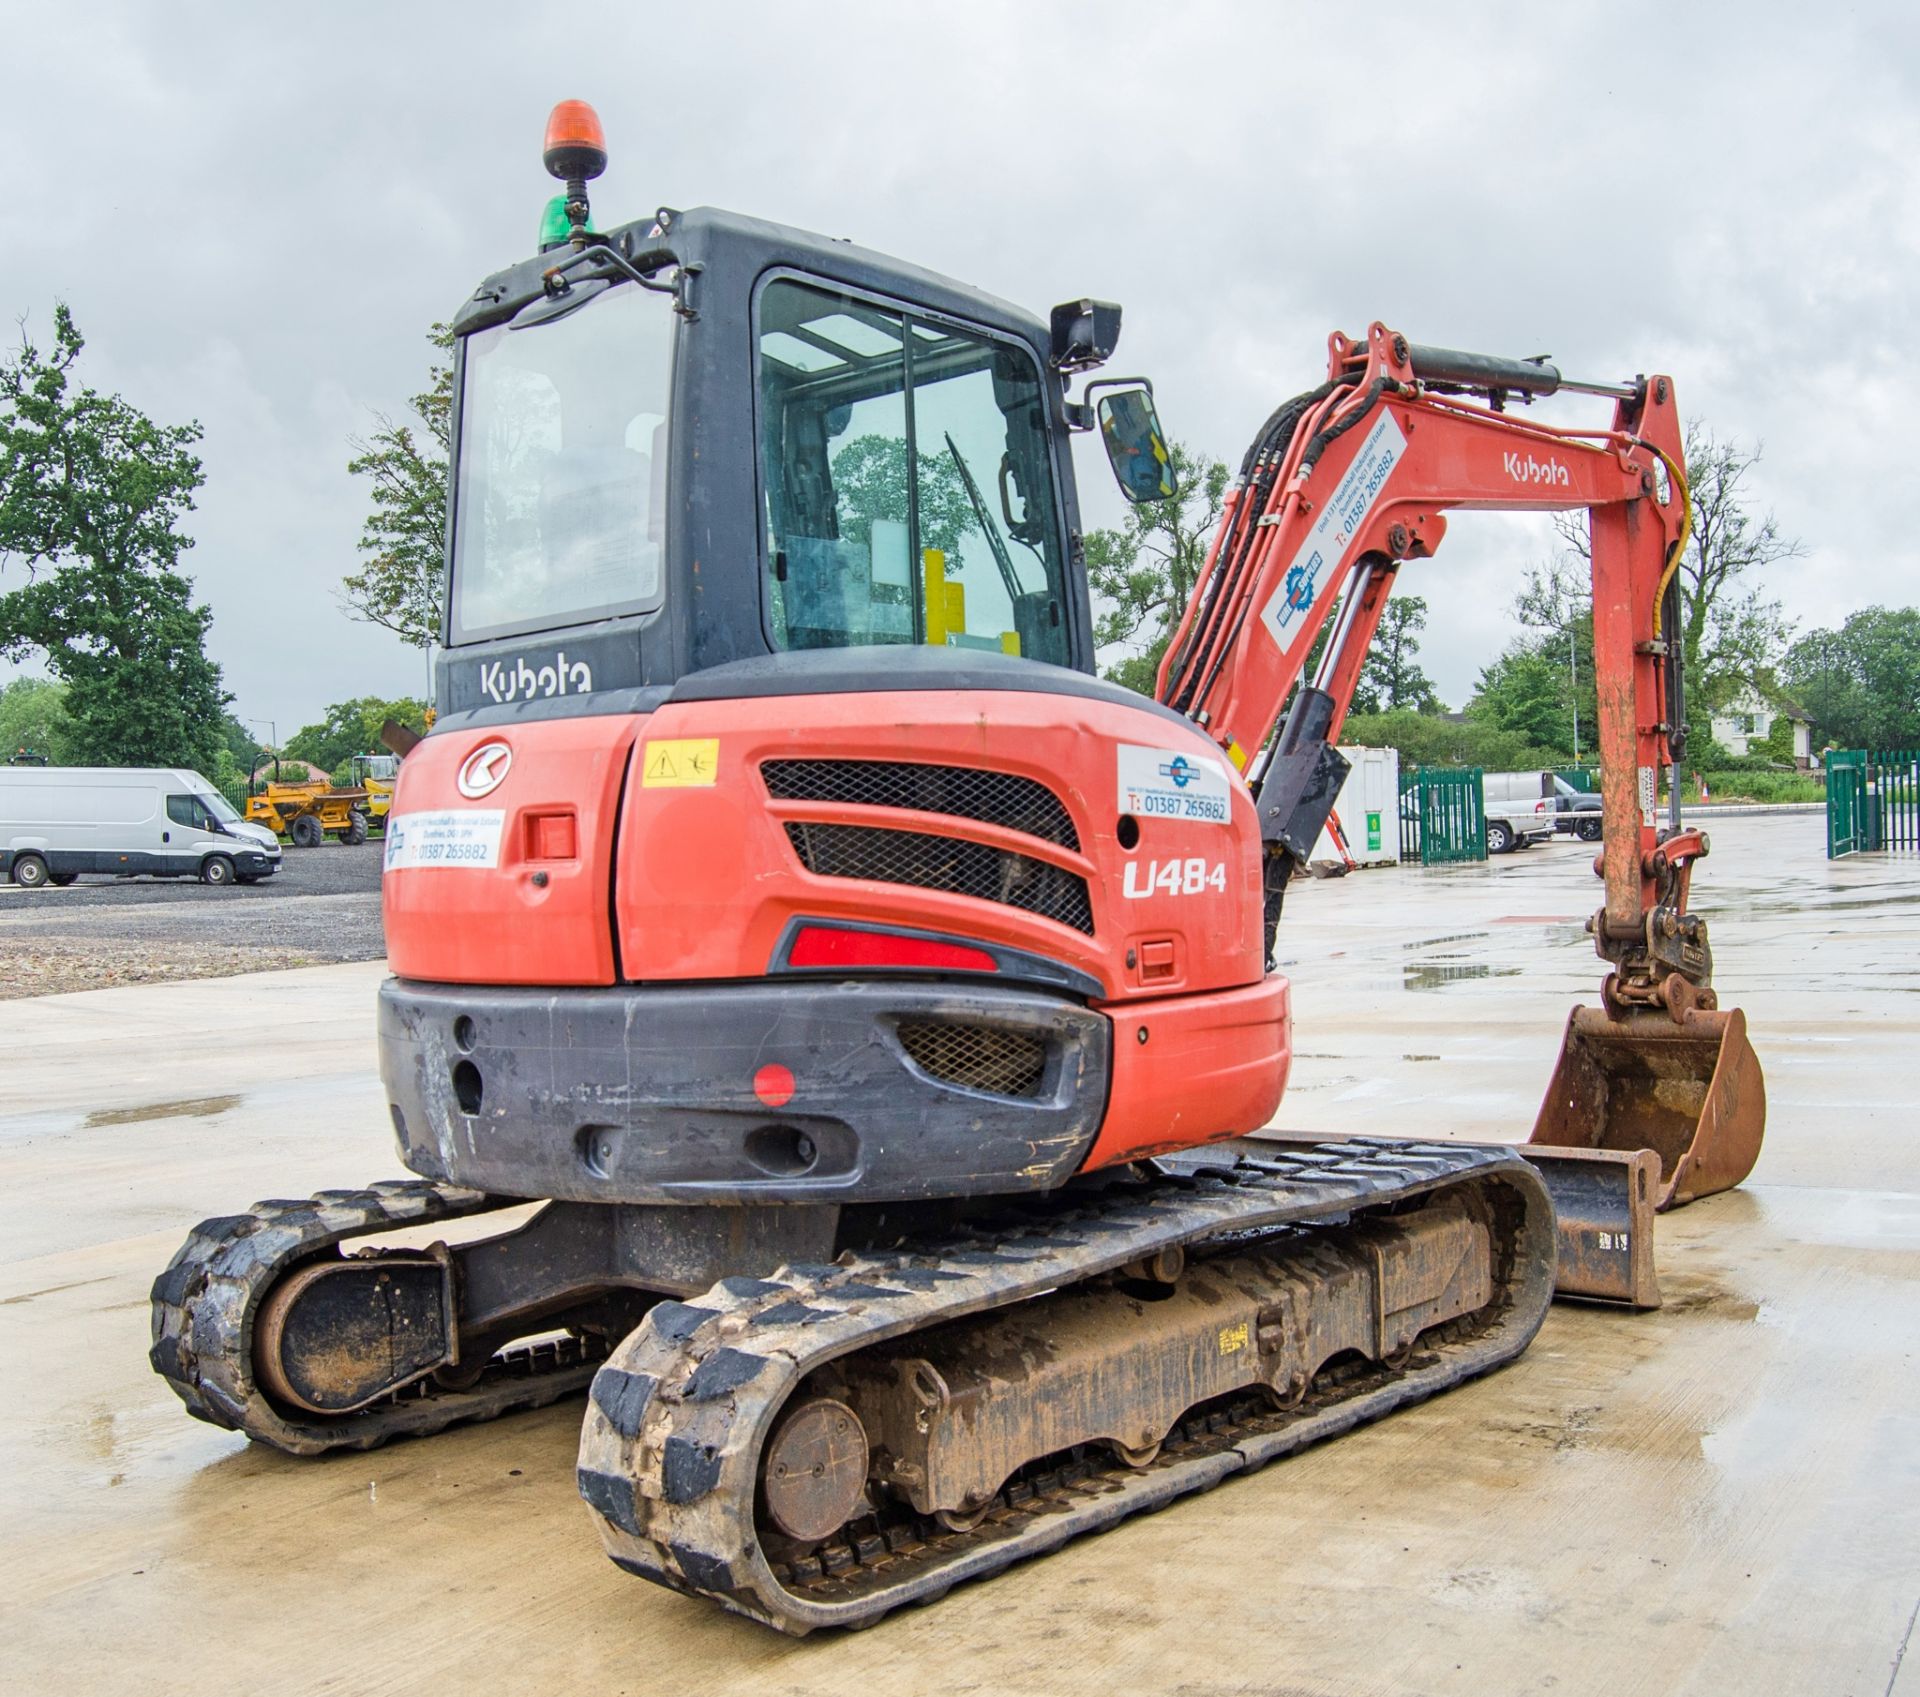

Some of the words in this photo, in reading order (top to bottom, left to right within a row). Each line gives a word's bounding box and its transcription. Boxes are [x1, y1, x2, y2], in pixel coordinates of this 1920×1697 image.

[1354, 440, 1374, 473] Industrial
[1372, 422, 1386, 443] Estate
[1503, 451, 1569, 486] Kubota
[1343, 494, 1368, 534] 01387
[1365, 449, 1395, 498] 265882
[481, 652, 592, 702] Kubota
[1128, 794, 1141, 811] T:
[1145, 795, 1181, 814] 01387
[1185, 800, 1225, 820] 265882
[419, 845, 445, 859] 01387
[446, 844, 487, 860] 265882
